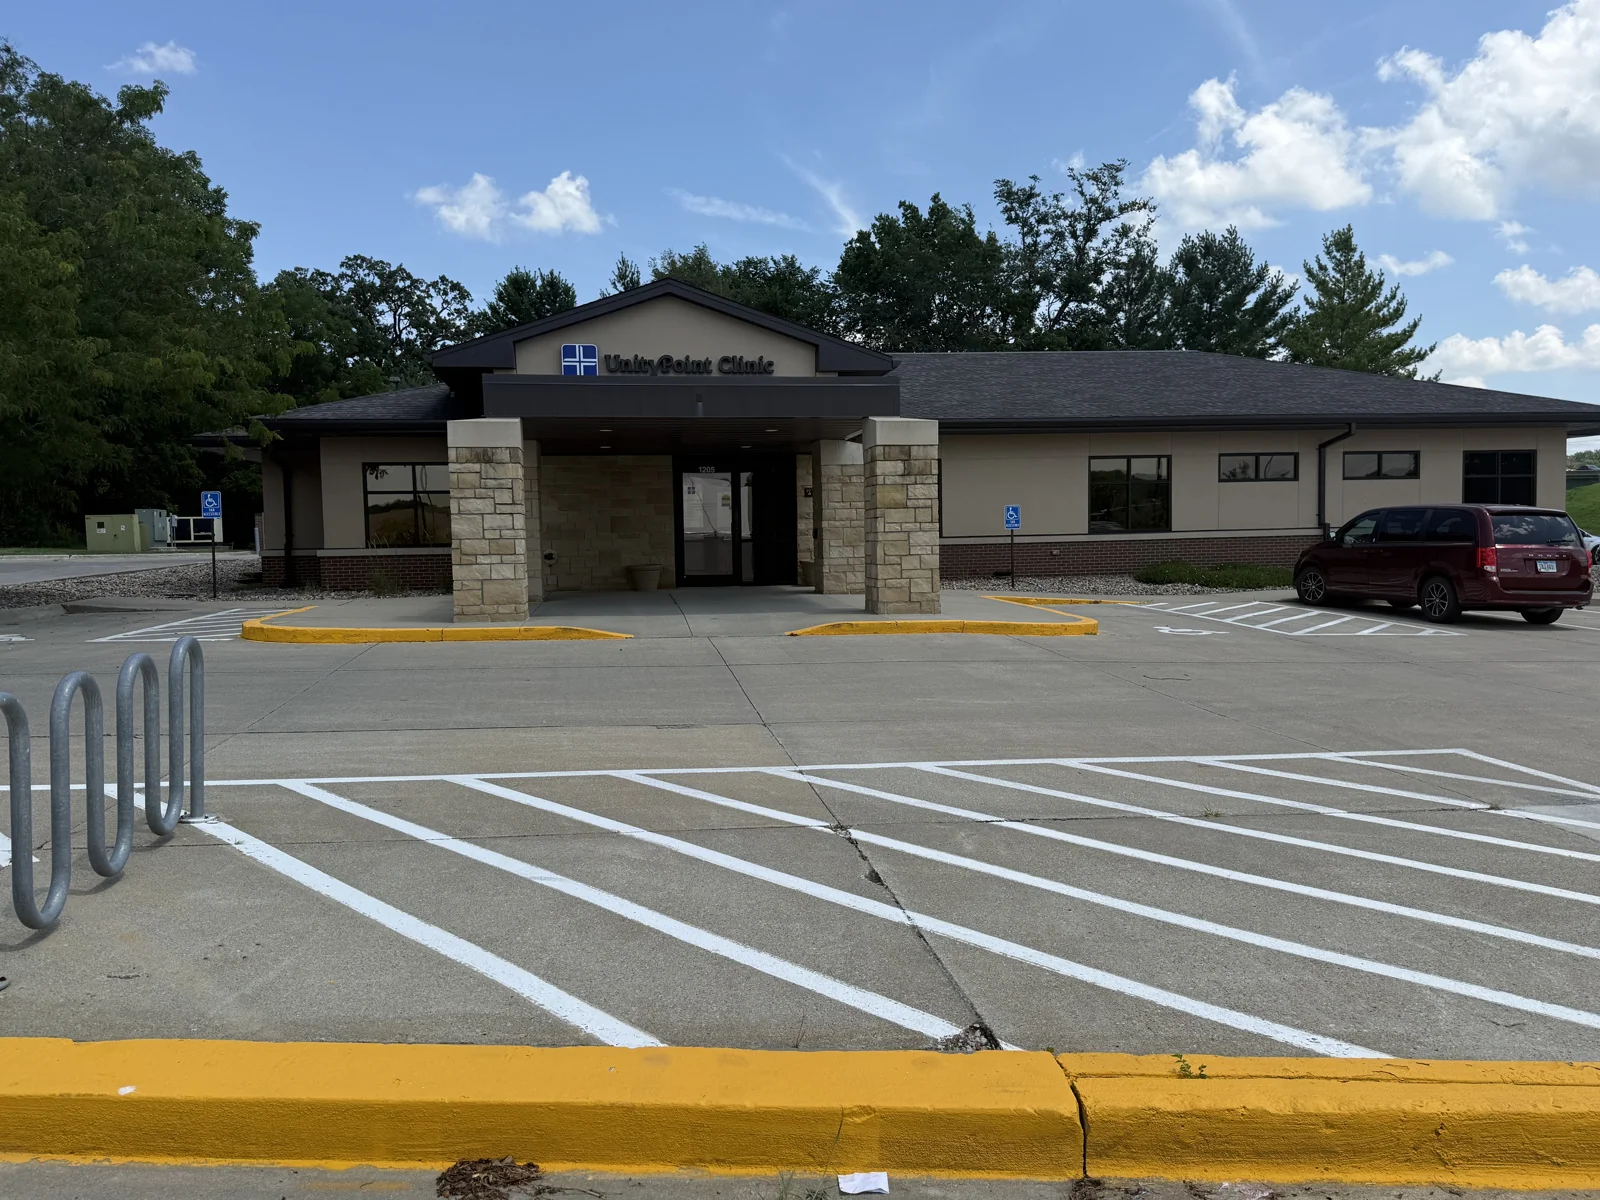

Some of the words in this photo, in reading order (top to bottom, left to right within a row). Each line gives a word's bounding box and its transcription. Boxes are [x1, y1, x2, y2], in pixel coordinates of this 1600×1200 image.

[604, 354, 713, 376] UnityPoint
[717, 355, 775, 375] Clinic
[698, 465, 716, 473] 1205
